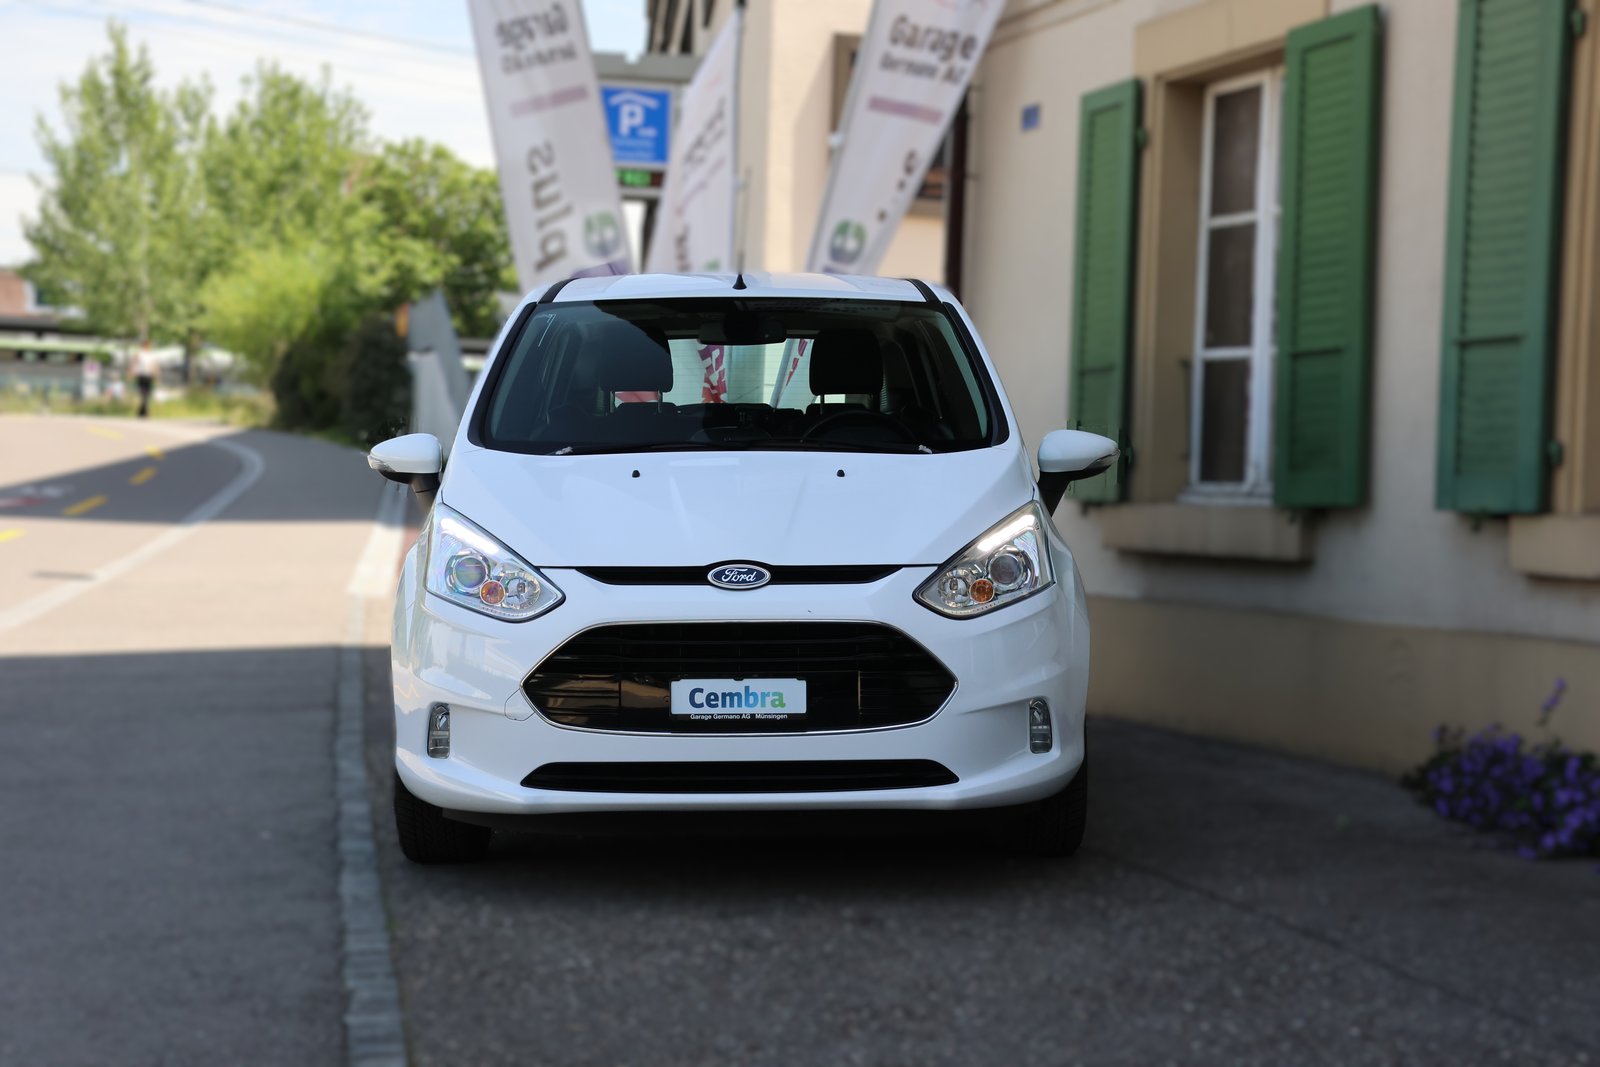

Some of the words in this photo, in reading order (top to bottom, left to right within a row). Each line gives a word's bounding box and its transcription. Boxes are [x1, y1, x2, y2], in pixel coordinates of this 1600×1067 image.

[889, 14, 977, 61] Garage
[618, 103, 645, 137] P
[721, 568, 757, 582] Ford
[688, 685, 786, 709] Cembra
[755, 712, 788, 720] Münsingen
